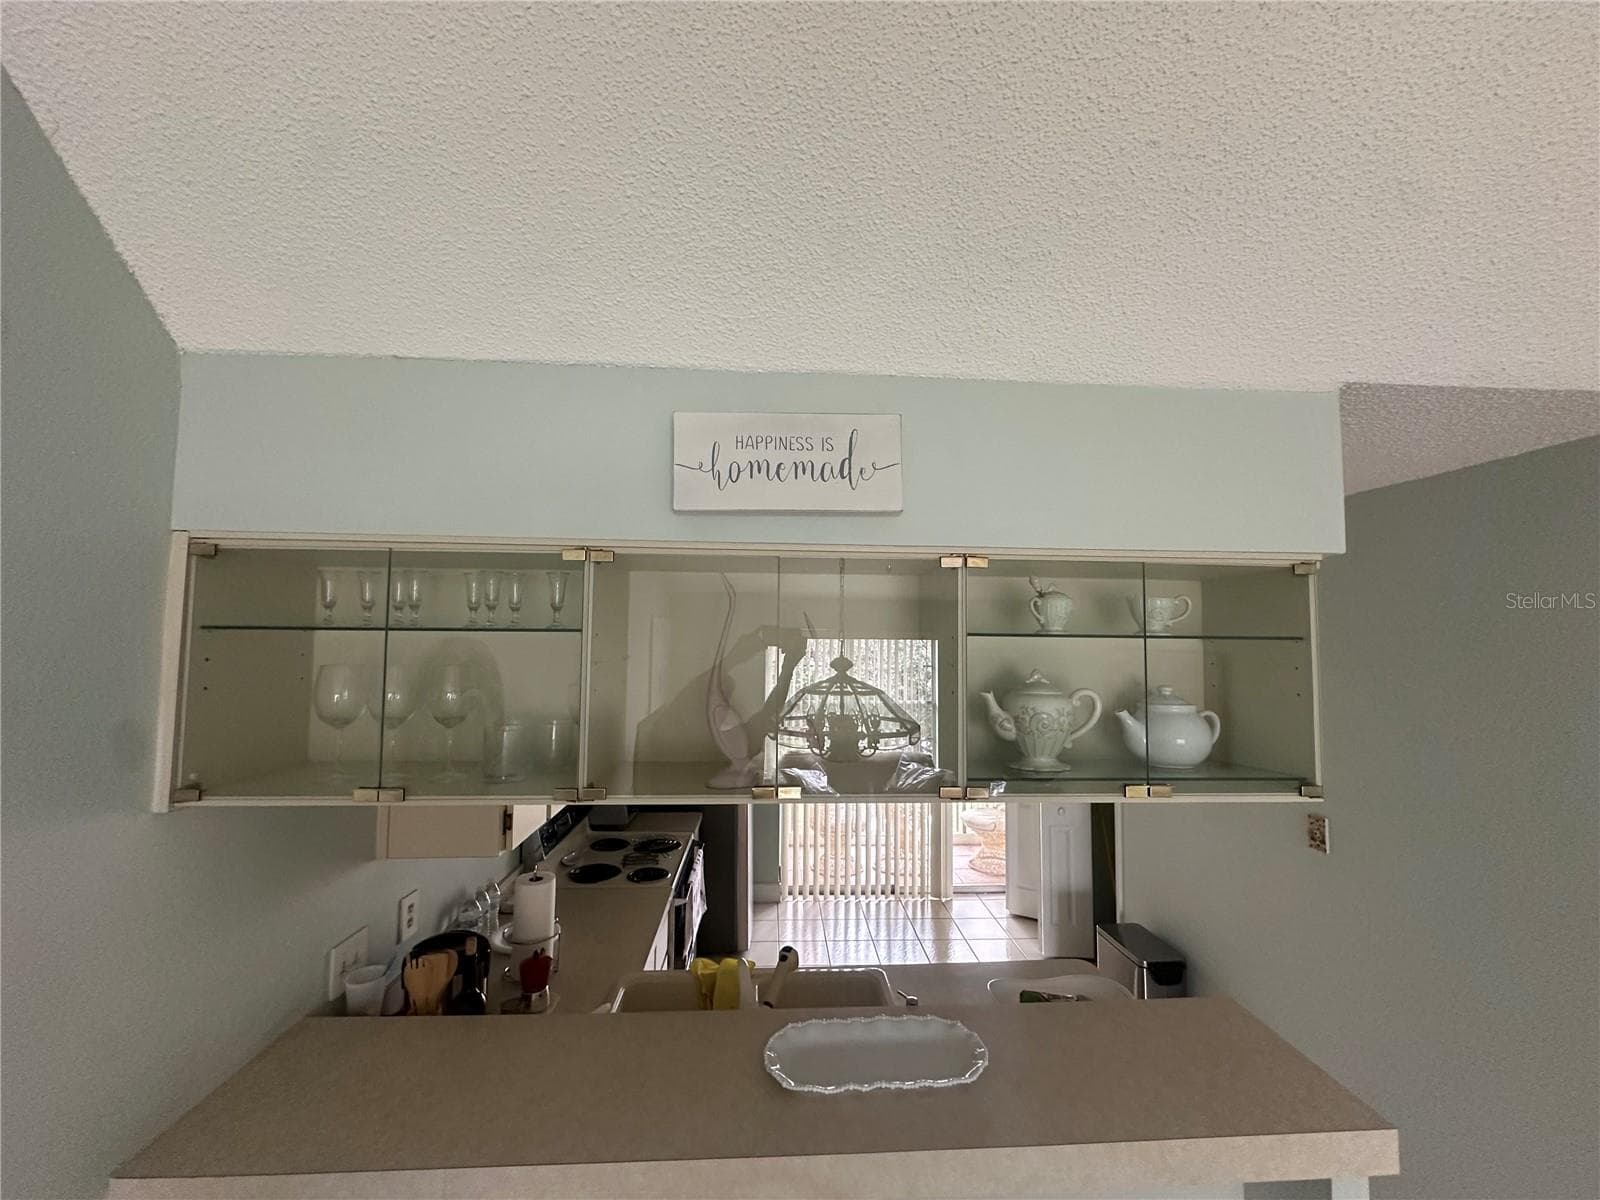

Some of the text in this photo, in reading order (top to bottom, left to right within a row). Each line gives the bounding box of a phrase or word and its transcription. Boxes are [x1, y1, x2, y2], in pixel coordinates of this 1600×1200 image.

[675, 428, 900, 491] homemade
[735, 435, 834, 452] HAPPINESS IS
